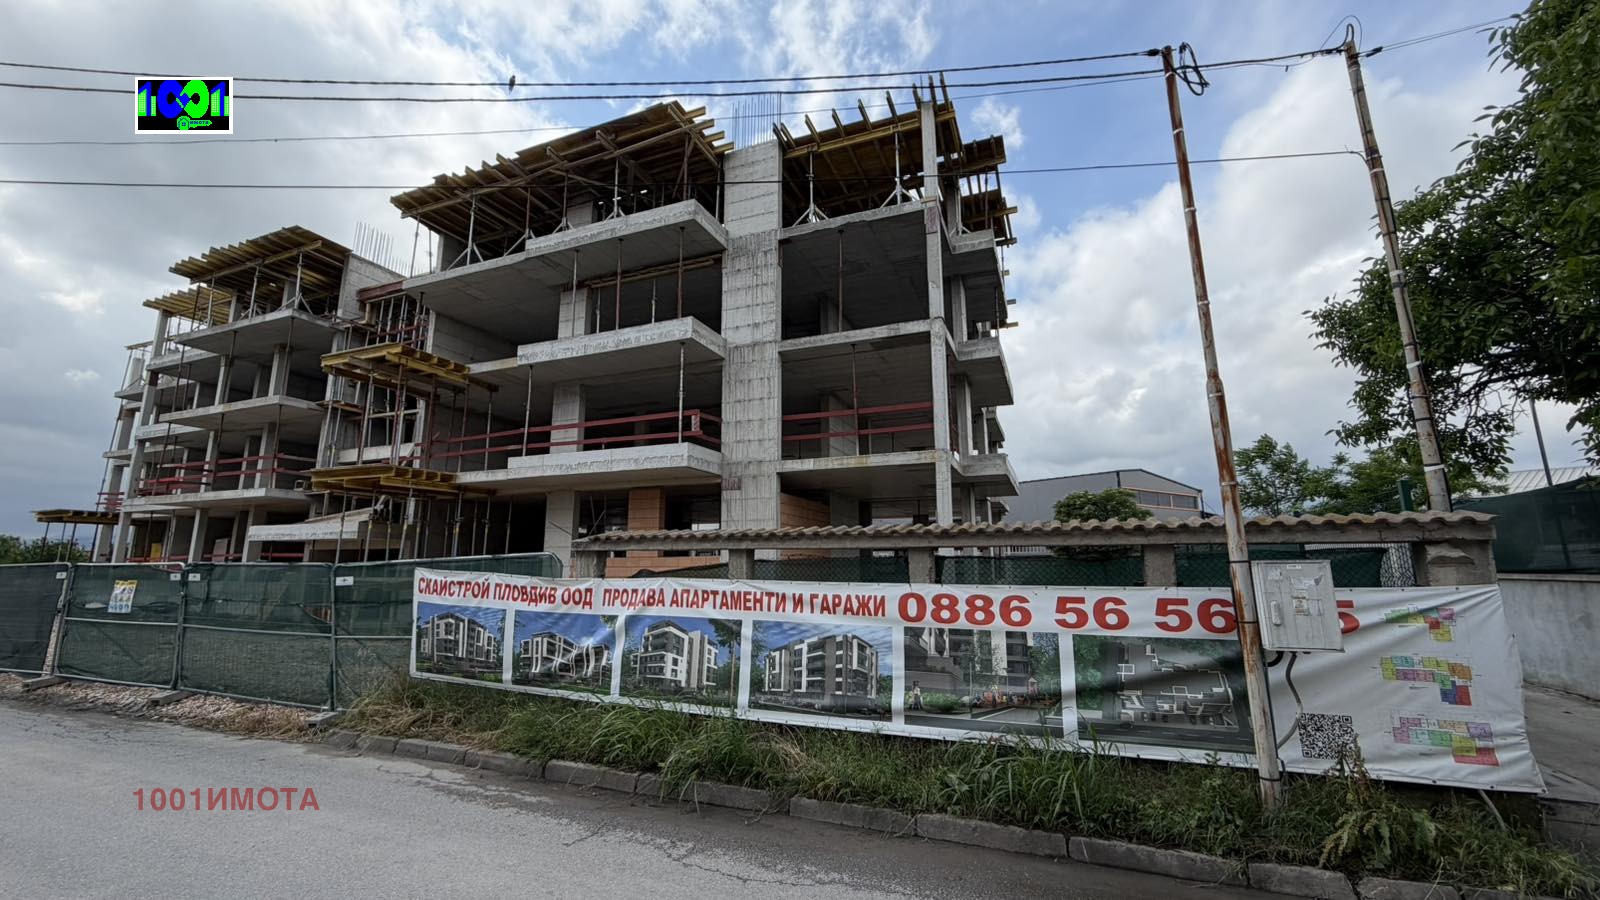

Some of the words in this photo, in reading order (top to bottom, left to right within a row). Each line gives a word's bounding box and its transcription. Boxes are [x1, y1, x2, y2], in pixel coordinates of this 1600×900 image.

[418, 576, 490, 599] СКАЙСТРОЙ
[493, 584, 557, 606] ПЛОВДИВ
[561, 587, 593, 609] ООД
[602, 588, 665, 610] ПРОДАВА
[669, 588, 786, 612] АПАРТАМЕНТИ
[792, 592, 804, 614] И
[809, 593, 886, 617] ГАРАЖИ
[898, 592, 1033, 627] 0886
[1054, 596, 1130, 631] 56
[1154, 598, 1239, 634] 56
